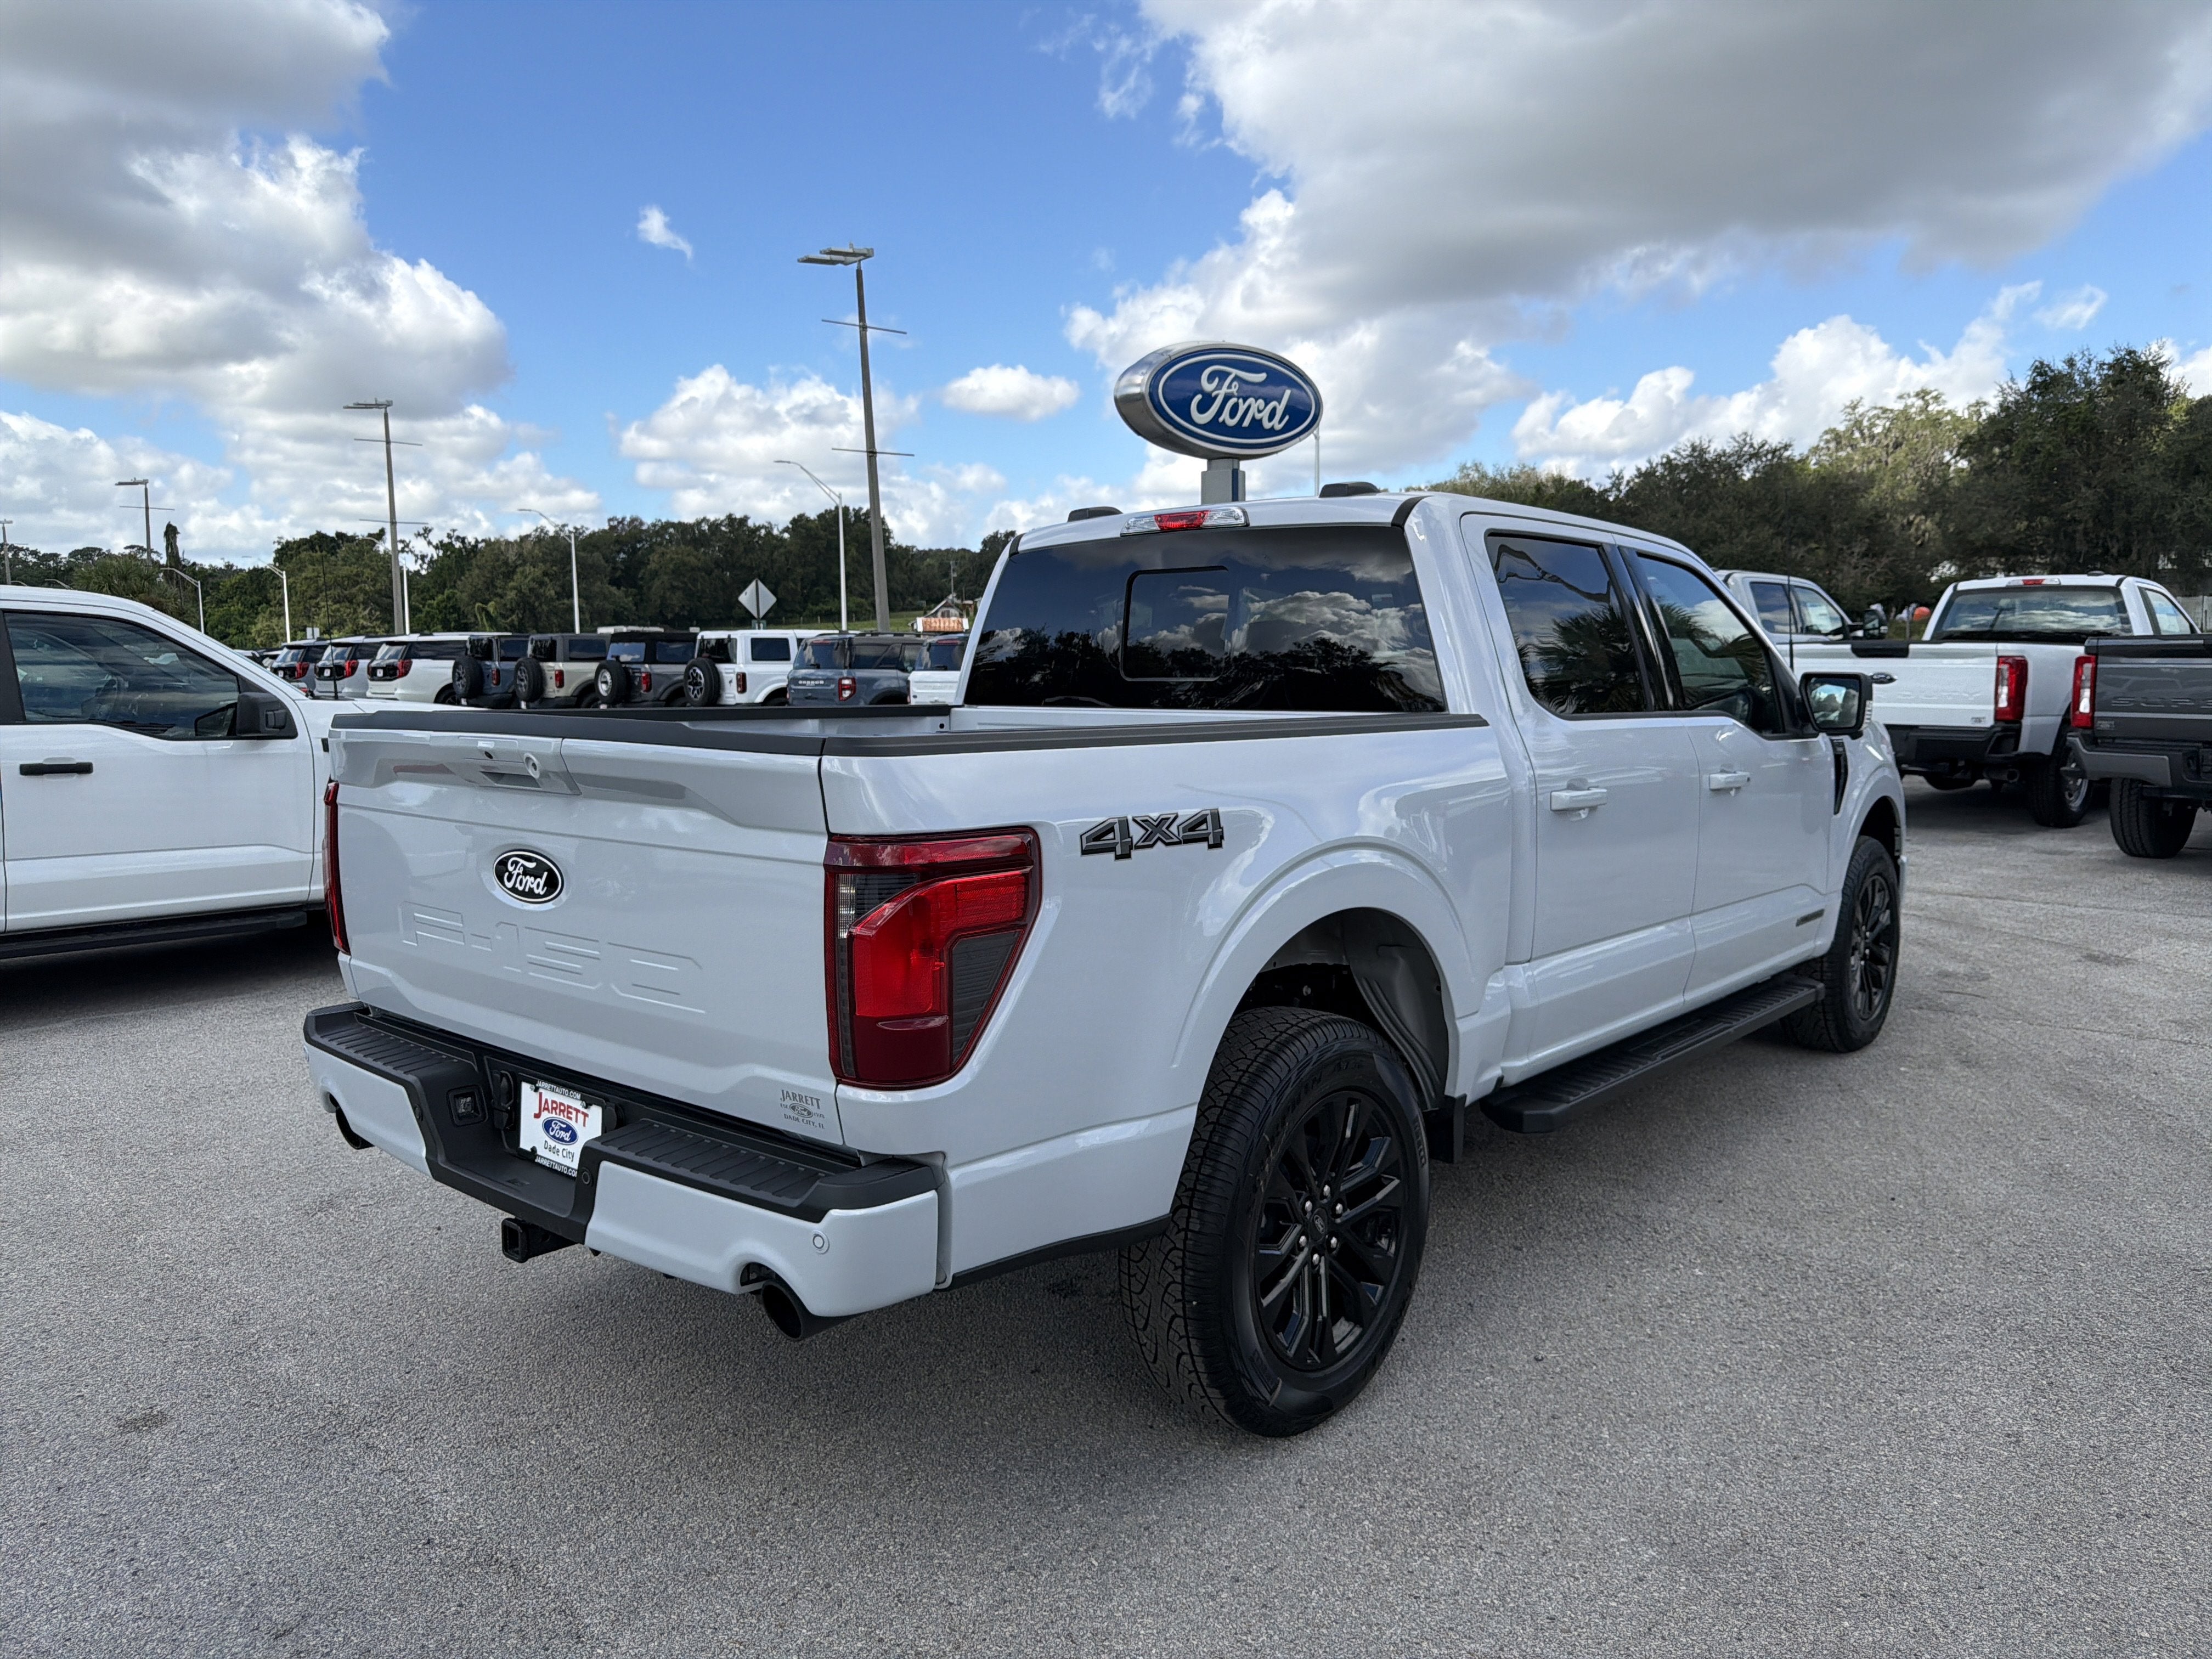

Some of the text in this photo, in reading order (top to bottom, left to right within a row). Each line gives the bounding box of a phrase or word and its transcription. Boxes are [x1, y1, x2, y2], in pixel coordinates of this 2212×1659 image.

[1190, 365, 1291, 431] Ford
[504, 857, 548, 895] Ford
[397, 900, 706, 1014] F-150
[535, 1080, 581, 1100] JARRETTAUTO.COM
[780, 1089, 821, 1110] JARRETT
[533, 1092, 589, 1127] JARRETT
[549, 1120, 572, 1142] Ford
[544, 1139, 575, 1163] Dade City
